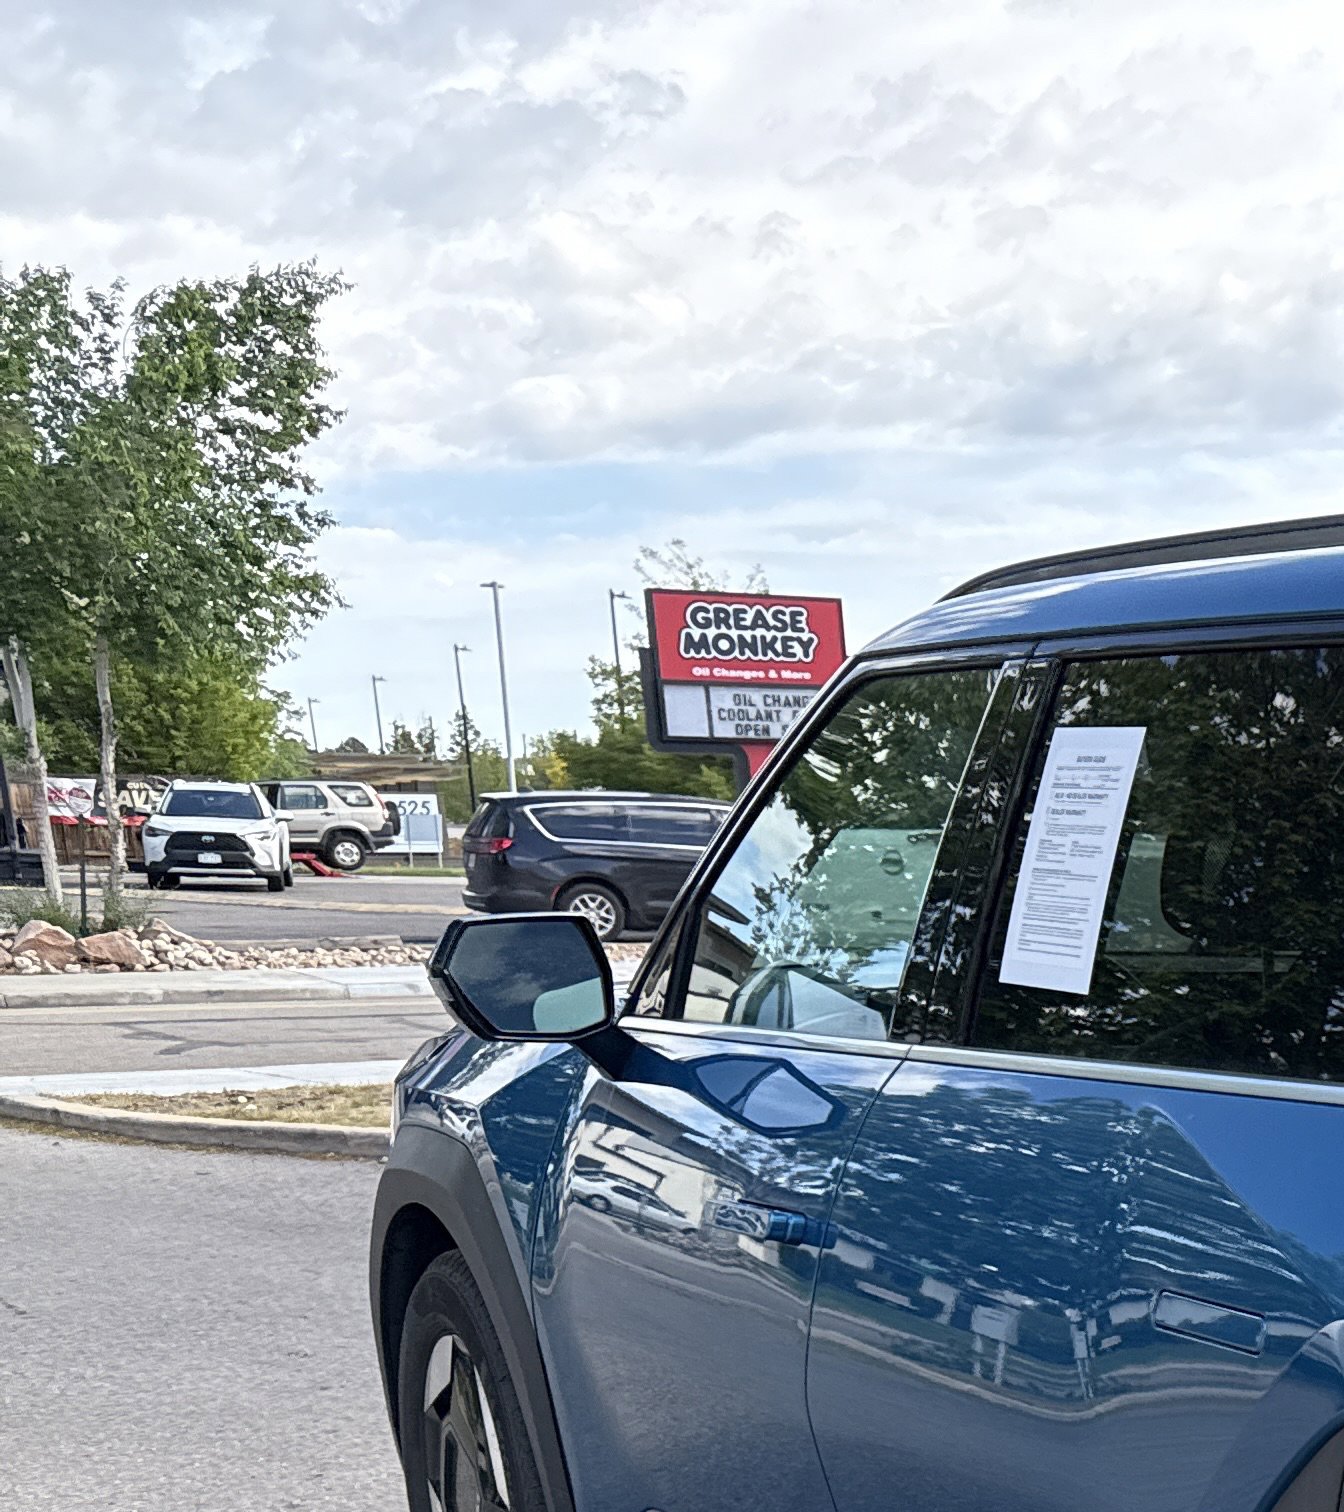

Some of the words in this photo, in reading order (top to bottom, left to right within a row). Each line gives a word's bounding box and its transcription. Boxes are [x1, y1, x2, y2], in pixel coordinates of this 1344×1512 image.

[689, 605, 806, 633] GREASE
[683, 631, 815, 660] MONKEY
[692, 666, 711, 676] Oil
[713, 667, 765, 680] Changes
[769, 669, 778, 678] &
[781, 670, 812, 680] More
[732, 693, 756, 707] OIL
[763, 694, 816, 708] CHANG
[717, 708, 782, 722] COOLANT
[735, 723, 770, 736] OPEN
[398, 800, 430, 815] 525
